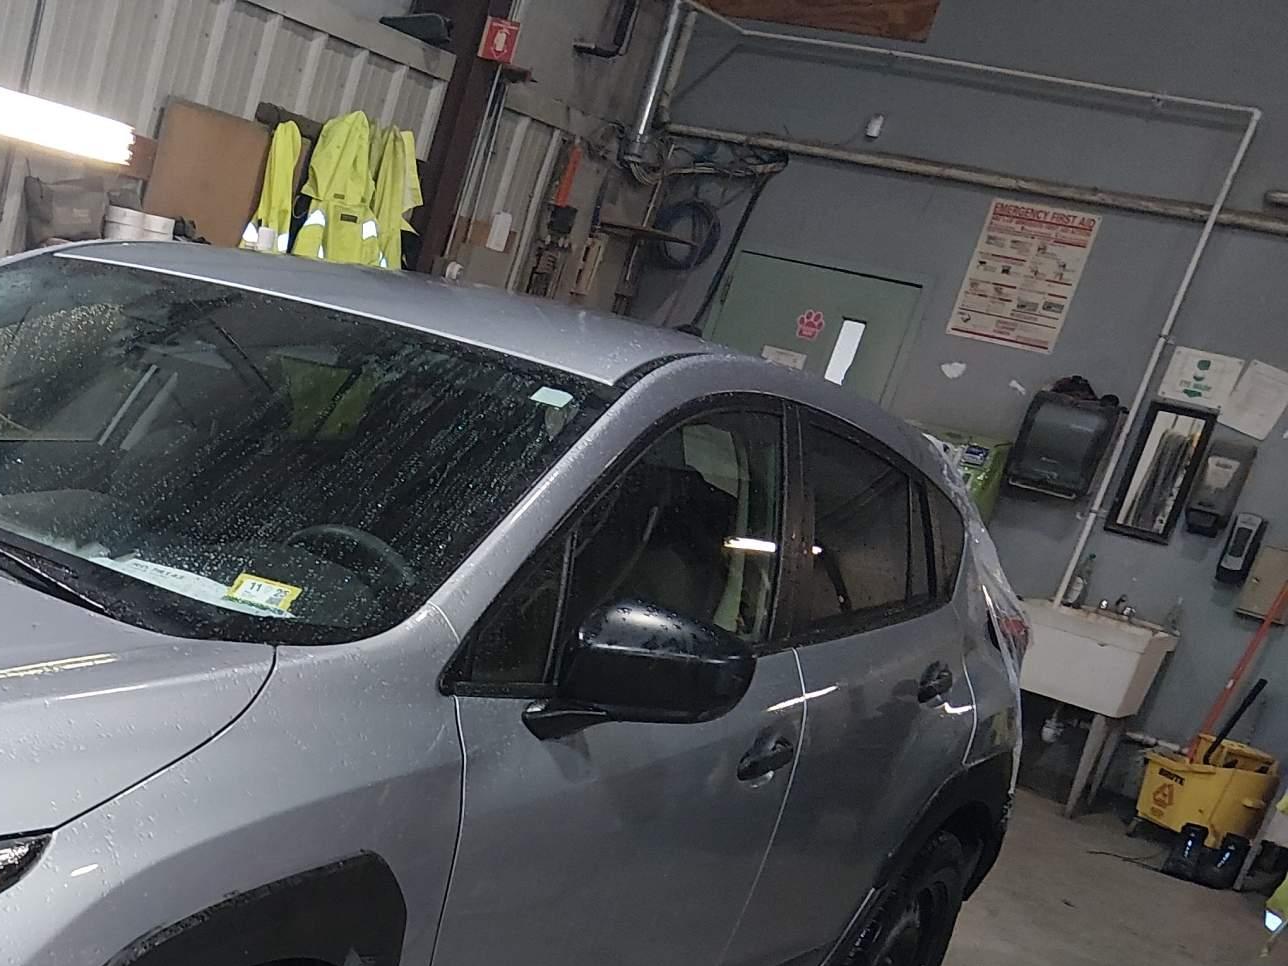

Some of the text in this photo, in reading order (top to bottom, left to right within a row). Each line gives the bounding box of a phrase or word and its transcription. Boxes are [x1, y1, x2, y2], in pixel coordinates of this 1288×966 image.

[994, 203, 1050, 220] EMERGENCY
[1051, 211, 1078, 226] FIRST
[1079, 216, 1097, 228] AID
[250, 582, 263, 593] 11
